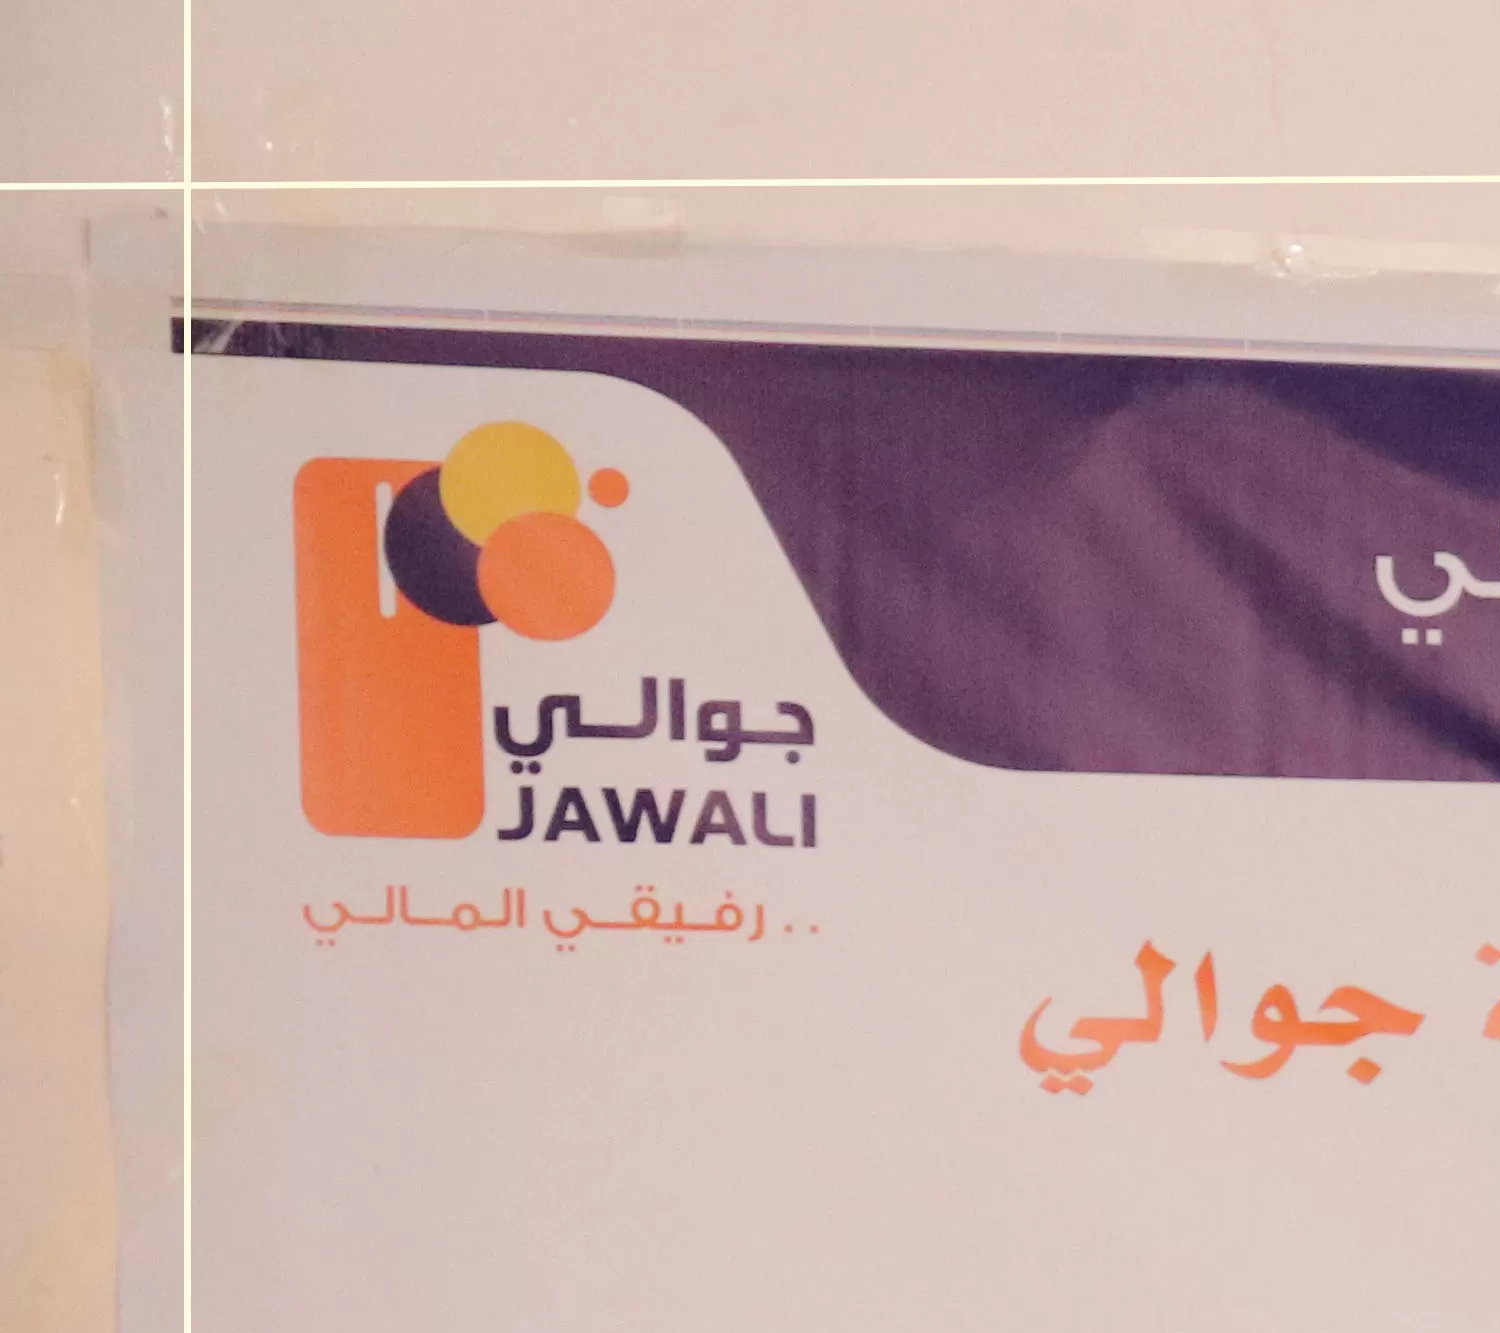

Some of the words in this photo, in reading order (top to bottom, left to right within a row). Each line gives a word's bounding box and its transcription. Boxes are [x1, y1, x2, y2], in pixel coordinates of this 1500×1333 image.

[493, 676, 816, 777] جوالي
[496, 785, 818, 849] JAWALI
[302, 883, 527, 949] المالي
[542, 884, 766, 954] رفيقي
[1019, 937, 1425, 1097] جوالي
